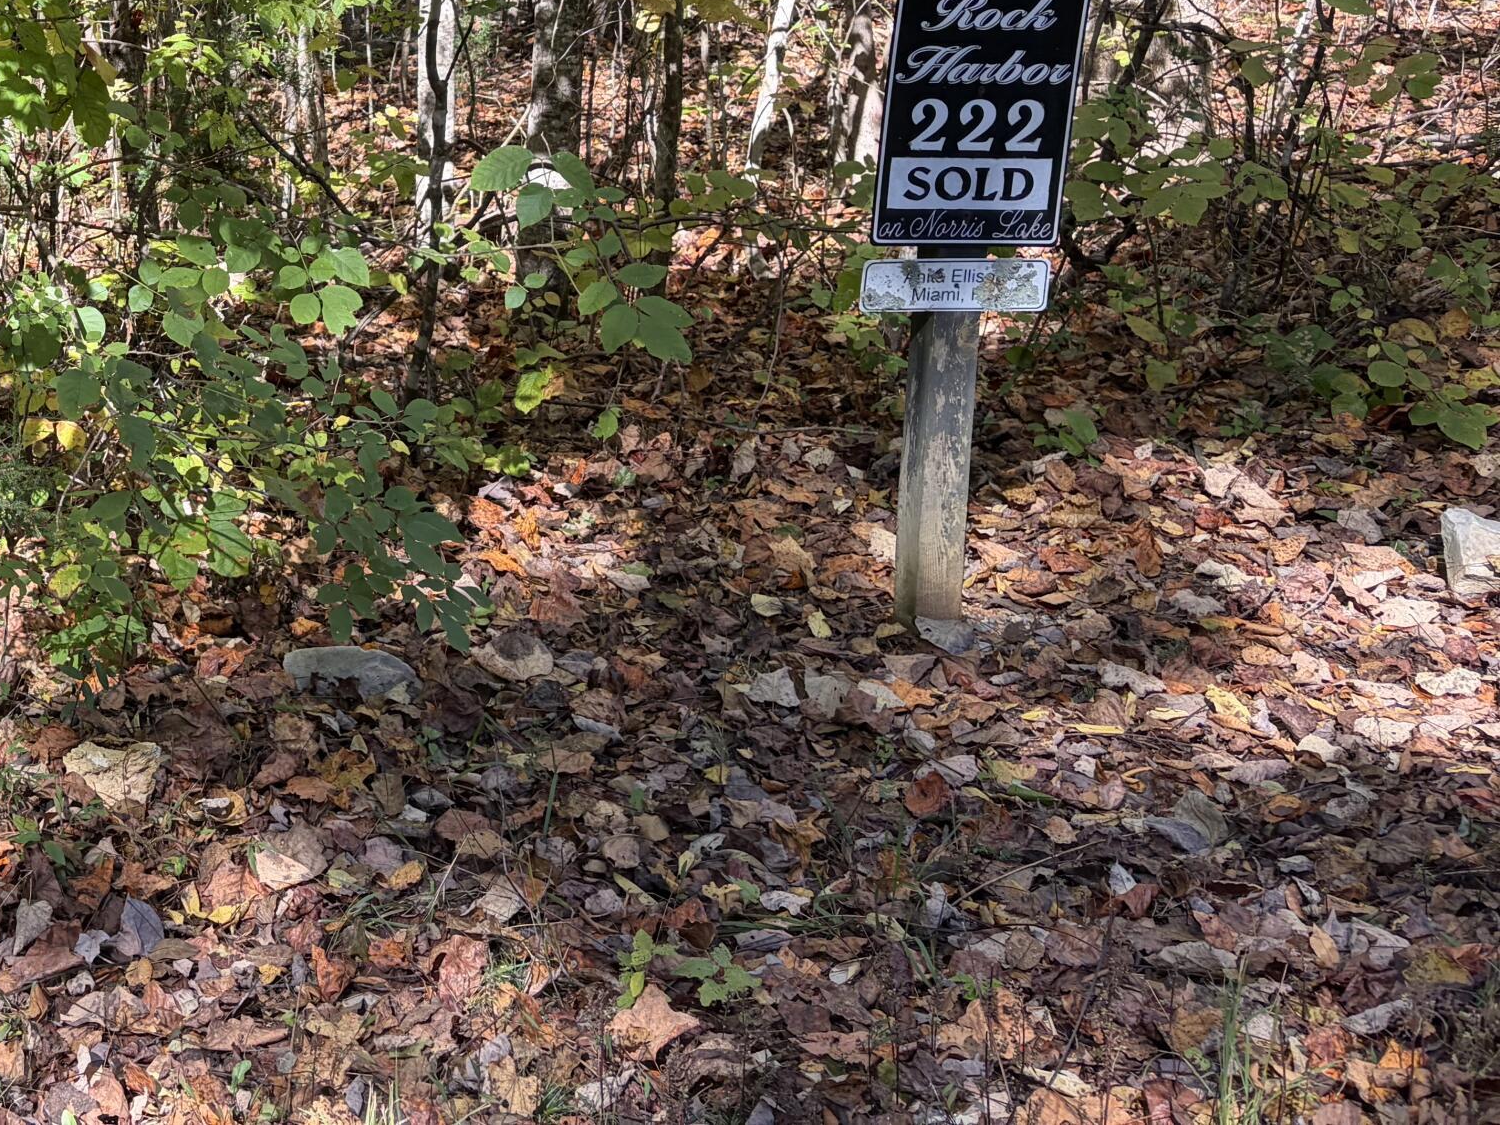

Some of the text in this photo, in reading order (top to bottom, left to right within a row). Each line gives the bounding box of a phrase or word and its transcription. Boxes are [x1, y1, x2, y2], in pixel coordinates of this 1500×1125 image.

[896, 45, 1072, 85] Harbor
[908, 98, 1045, 152] 222
[903, 166, 1035, 201] SOLD
[878, 209, 1052, 239] on Norris Lake
[911, 287, 964, 303] Miami,
